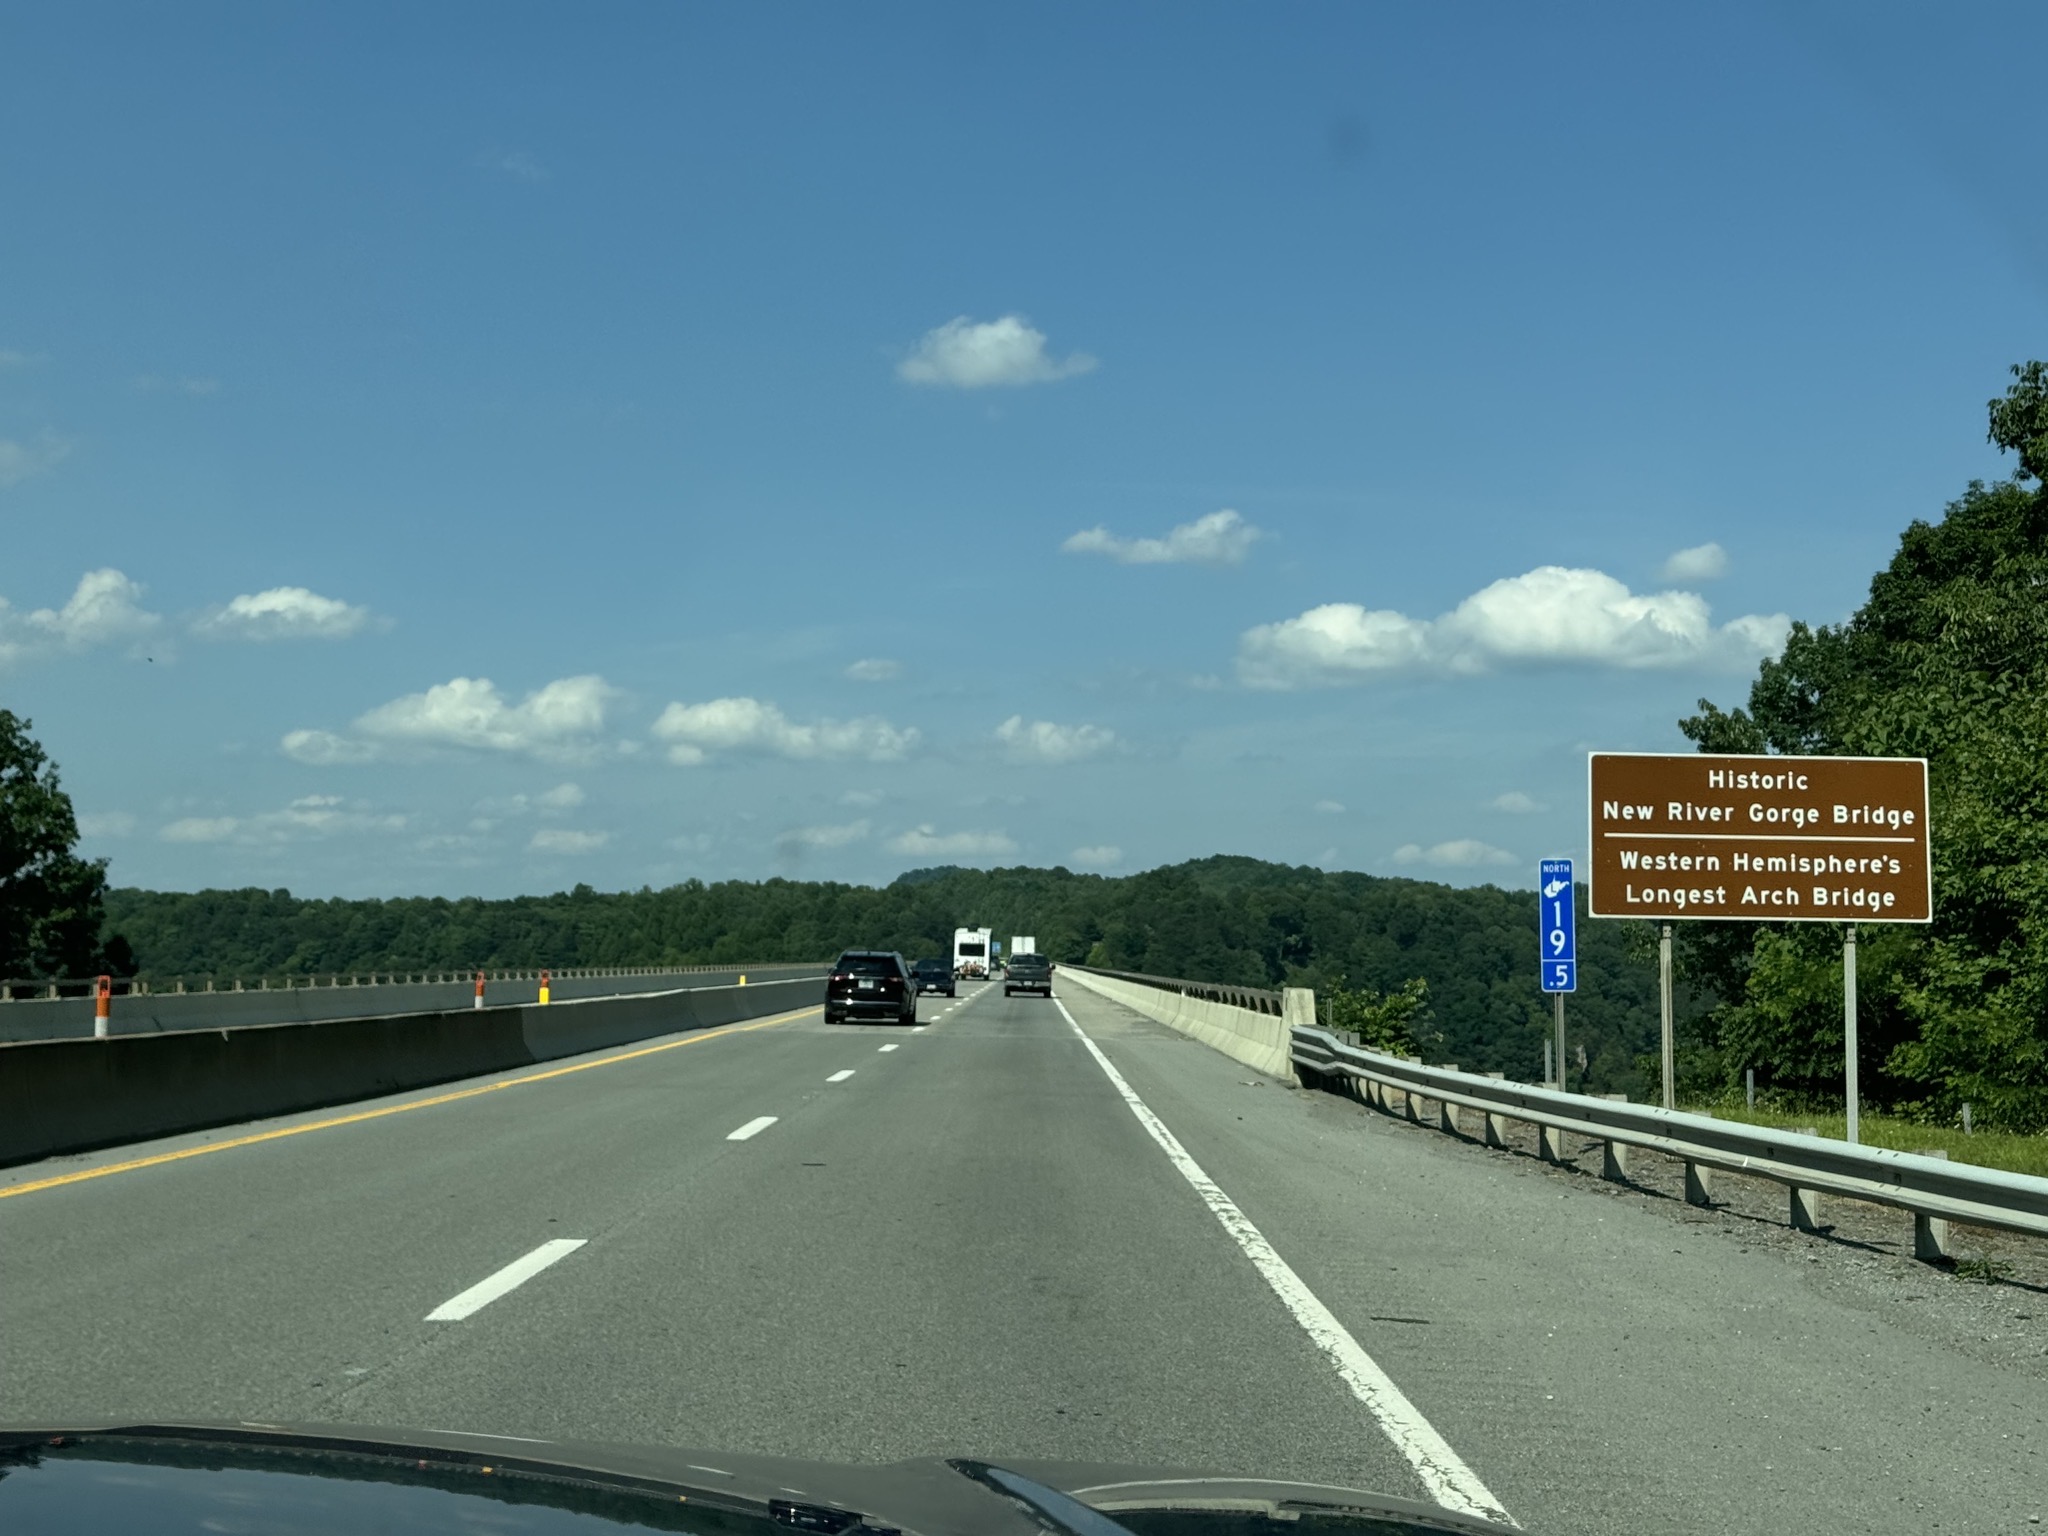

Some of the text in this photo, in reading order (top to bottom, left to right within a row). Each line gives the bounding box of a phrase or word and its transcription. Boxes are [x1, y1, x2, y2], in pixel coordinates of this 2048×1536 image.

[1708, 769, 1809, 790] Historic
[1602, 800, 1916, 830] New River Gorge Bridge
[1543, 864, 1570, 873] NORTH
[1619, 850, 1901, 876] Western Hemisphere's
[1626, 884, 1896, 912] Longest Arch Bridge
[1549, 964, 1568, 987] .5
